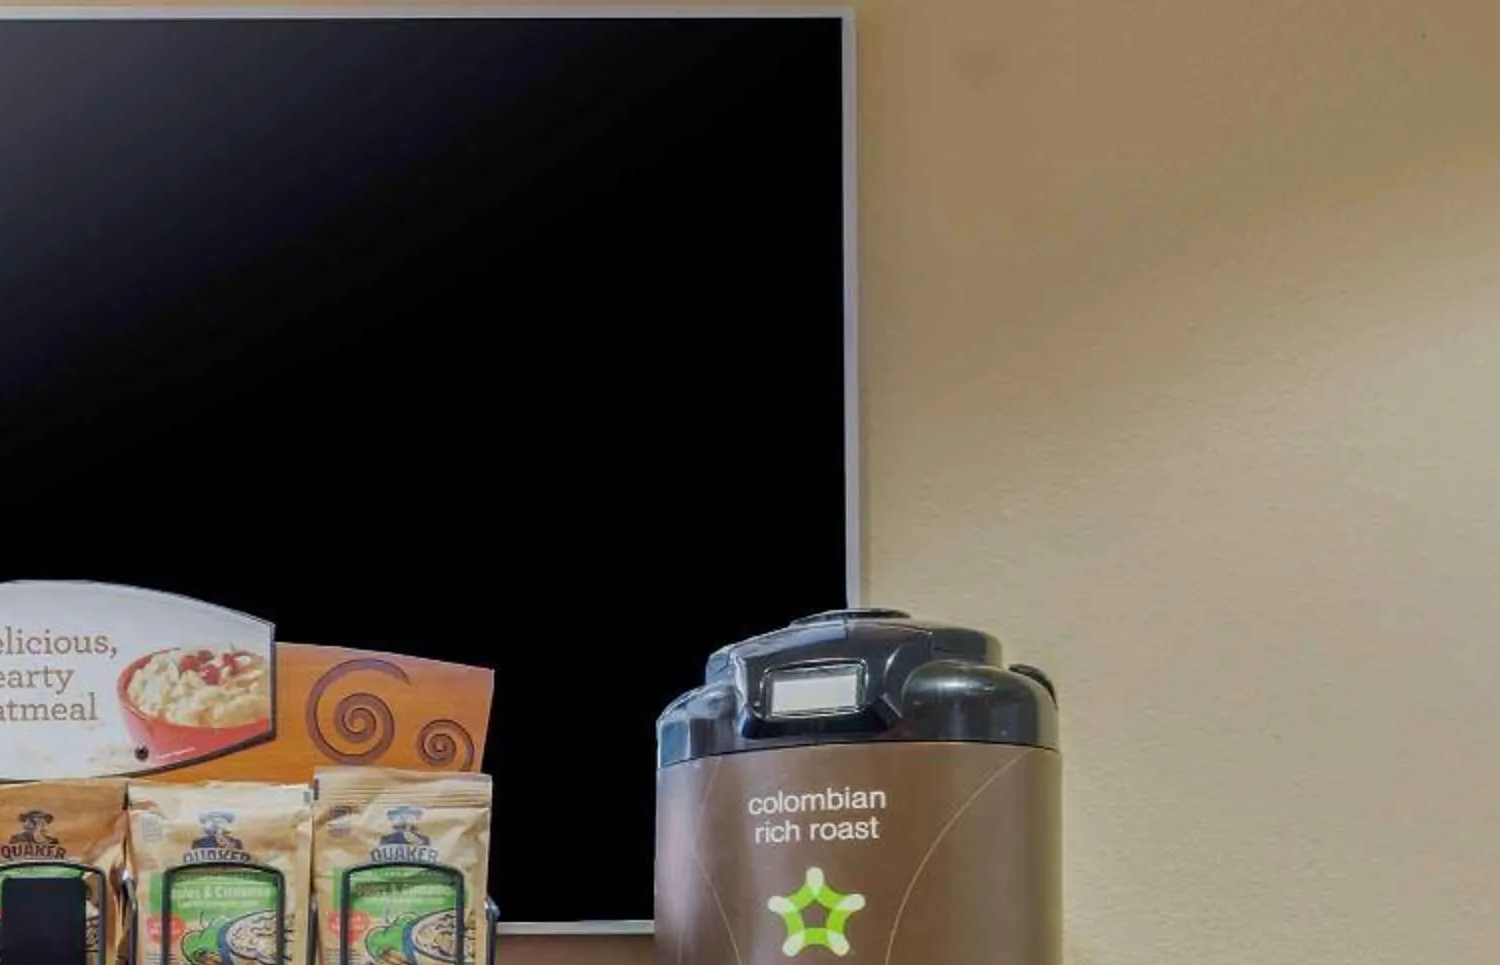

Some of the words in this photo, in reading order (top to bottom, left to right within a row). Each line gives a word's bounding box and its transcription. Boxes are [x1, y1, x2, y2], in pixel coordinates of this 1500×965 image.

[748, 786, 886, 816] colombian
[754, 820, 801, 844] rich
[809, 817, 880, 841] roast
[1, 843, 68, 859] QUAKER
[371, 846, 439, 863] QUAKER
